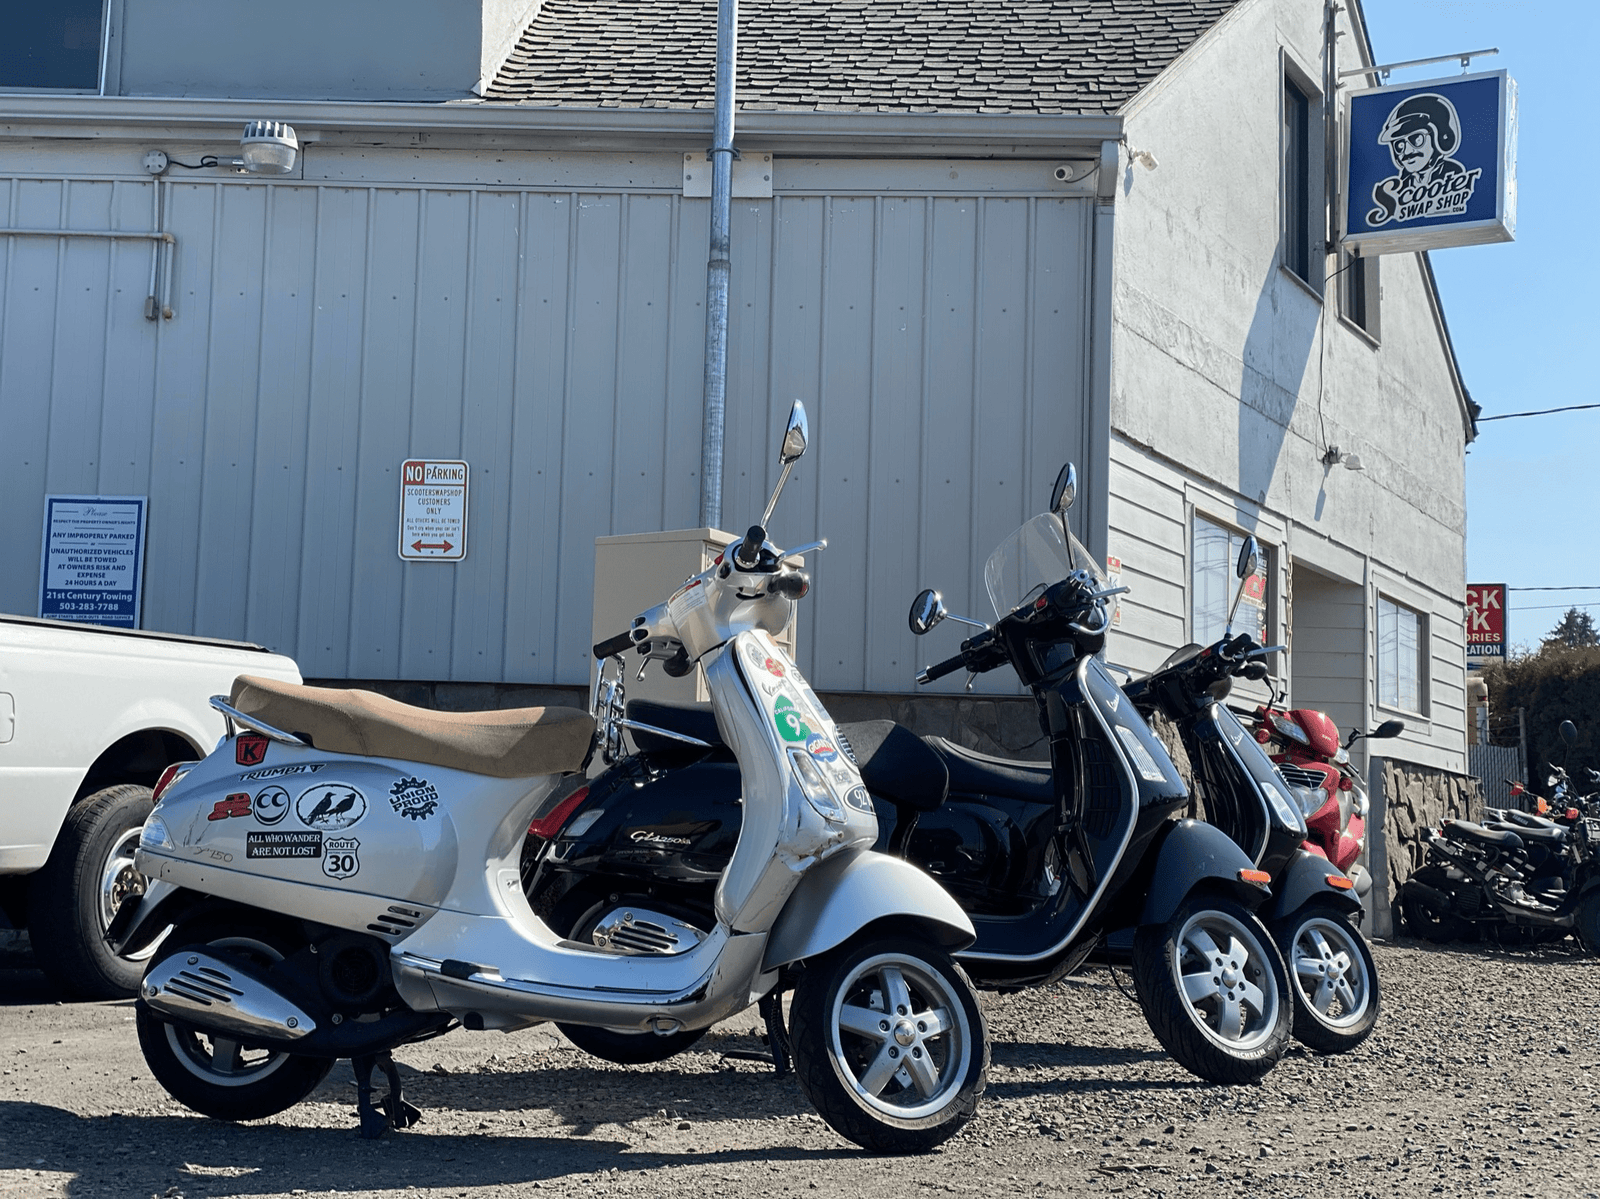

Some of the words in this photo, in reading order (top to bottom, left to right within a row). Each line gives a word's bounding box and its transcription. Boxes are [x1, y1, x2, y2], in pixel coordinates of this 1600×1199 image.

[1368, 170, 1480, 225] Scooter
[1399, 200, 1433, 220] SWAP
[1436, 191, 1469, 210] SHOP
[406, 465, 423, 482] NO
[426, 468, 463, 480] PARKING
[407, 488, 462, 497] SCOOTERSWAPSHOP
[417, 497, 451, 506] CUSTOMERS
[82, 506, 108, 517] Please
[426, 507, 441, 515] ONLY
[46, 591, 65, 600] 21st
[66, 591, 101, 602] Century
[102, 592, 133, 602] Towing
[59, 602, 119, 611] 503-283-7788
[786, 713, 801, 737] 9
[239, 765, 307, 781] TRIUMPH
[389, 784, 436, 805] UNION
[392, 792, 439, 813] PROUD
[248, 834, 264, 843] ALL
[265, 833, 283, 843] WHO
[284, 833, 321, 843] WANDER
[329, 841, 355, 849] ROUTE
[251, 847, 271, 856] ARE
[272, 846, 291, 856] NOT
[292, 846, 316, 856] LOST
[328, 854, 355, 872] 30
[1229, 1048, 1266, 1059] MICHELIN
